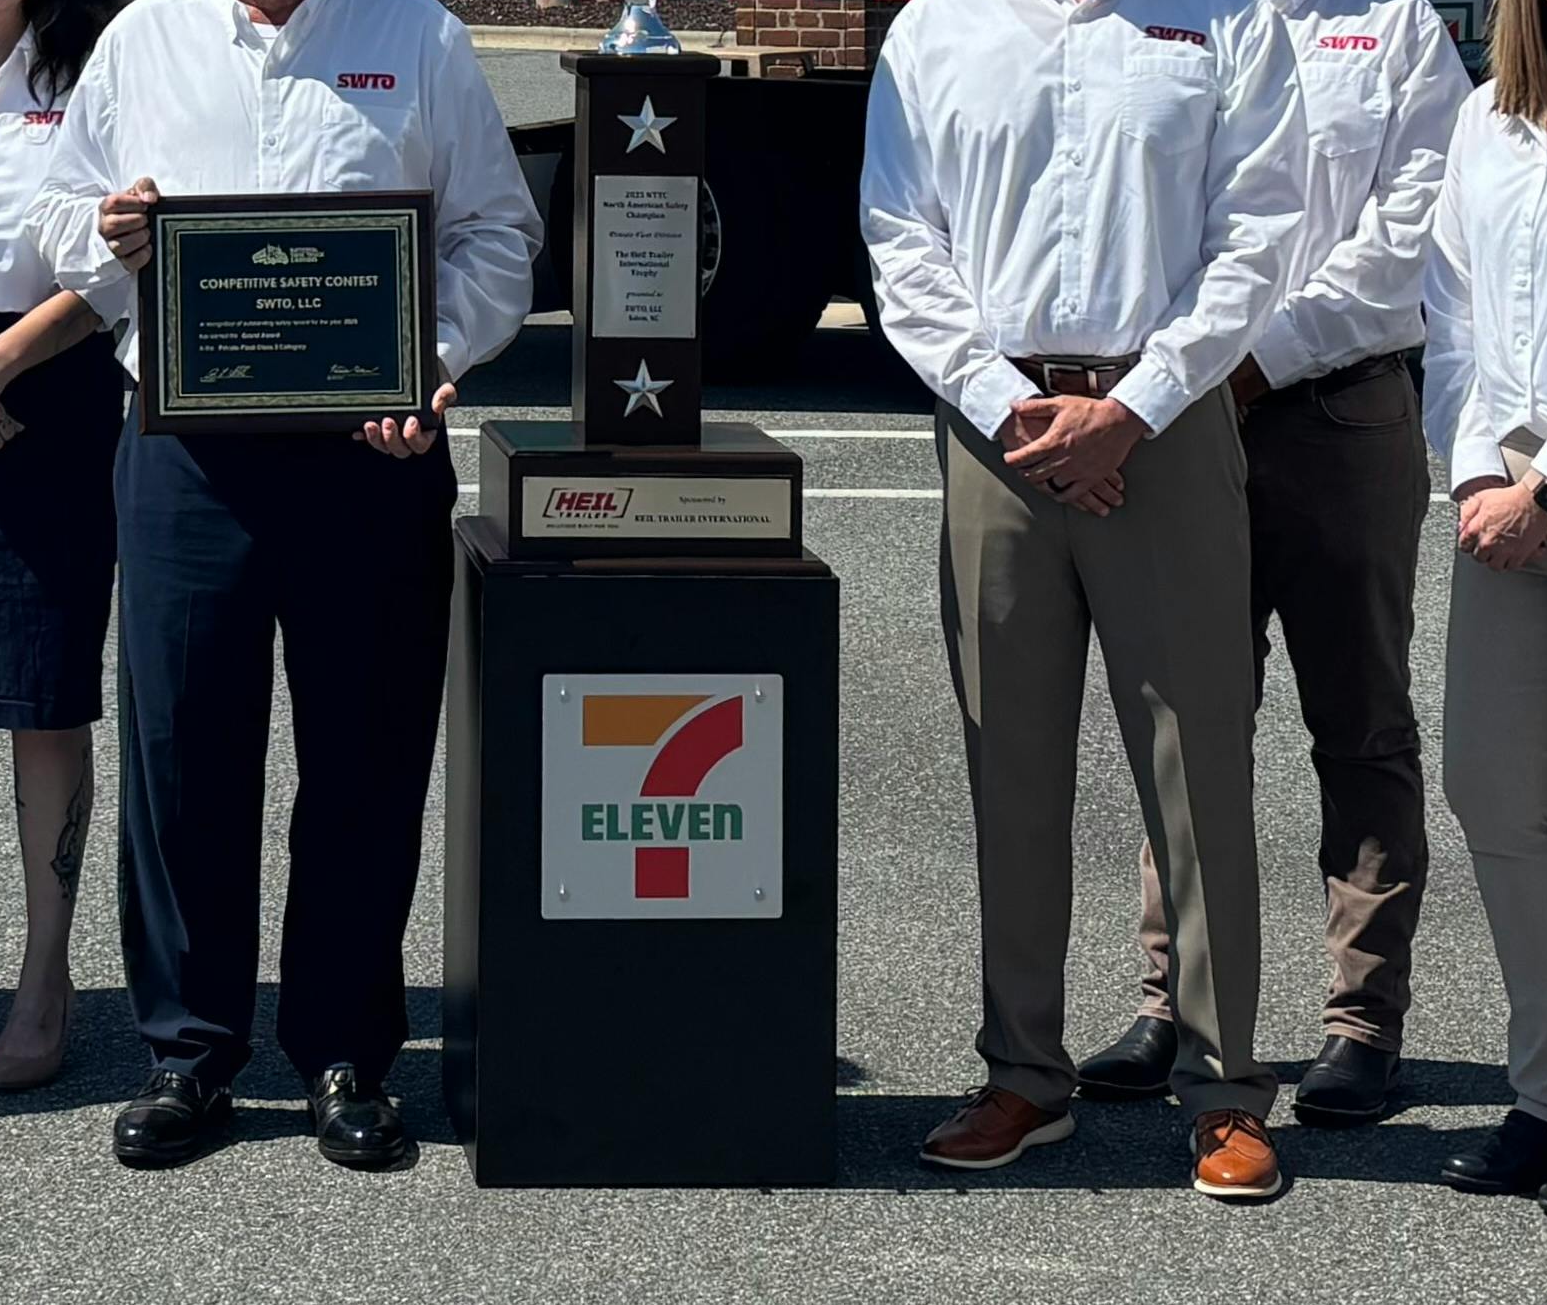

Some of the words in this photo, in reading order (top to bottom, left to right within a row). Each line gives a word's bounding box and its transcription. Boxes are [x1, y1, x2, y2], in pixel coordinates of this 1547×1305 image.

[1318, 36, 1380, 51] SWTO
[337, 73, 396, 90] SWTO
[22, 111, 65, 126] SWT
[199, 278, 278, 290] COMPETITIVE
[280, 276, 323, 288] SAFETY
[325, 275, 379, 287] CONTEST
[256, 298, 295, 310] SWTO,
[298, 297, 322, 308] LLC
[555, 492, 617, 511] HEIL
[583, 695, 743, 898] 7
